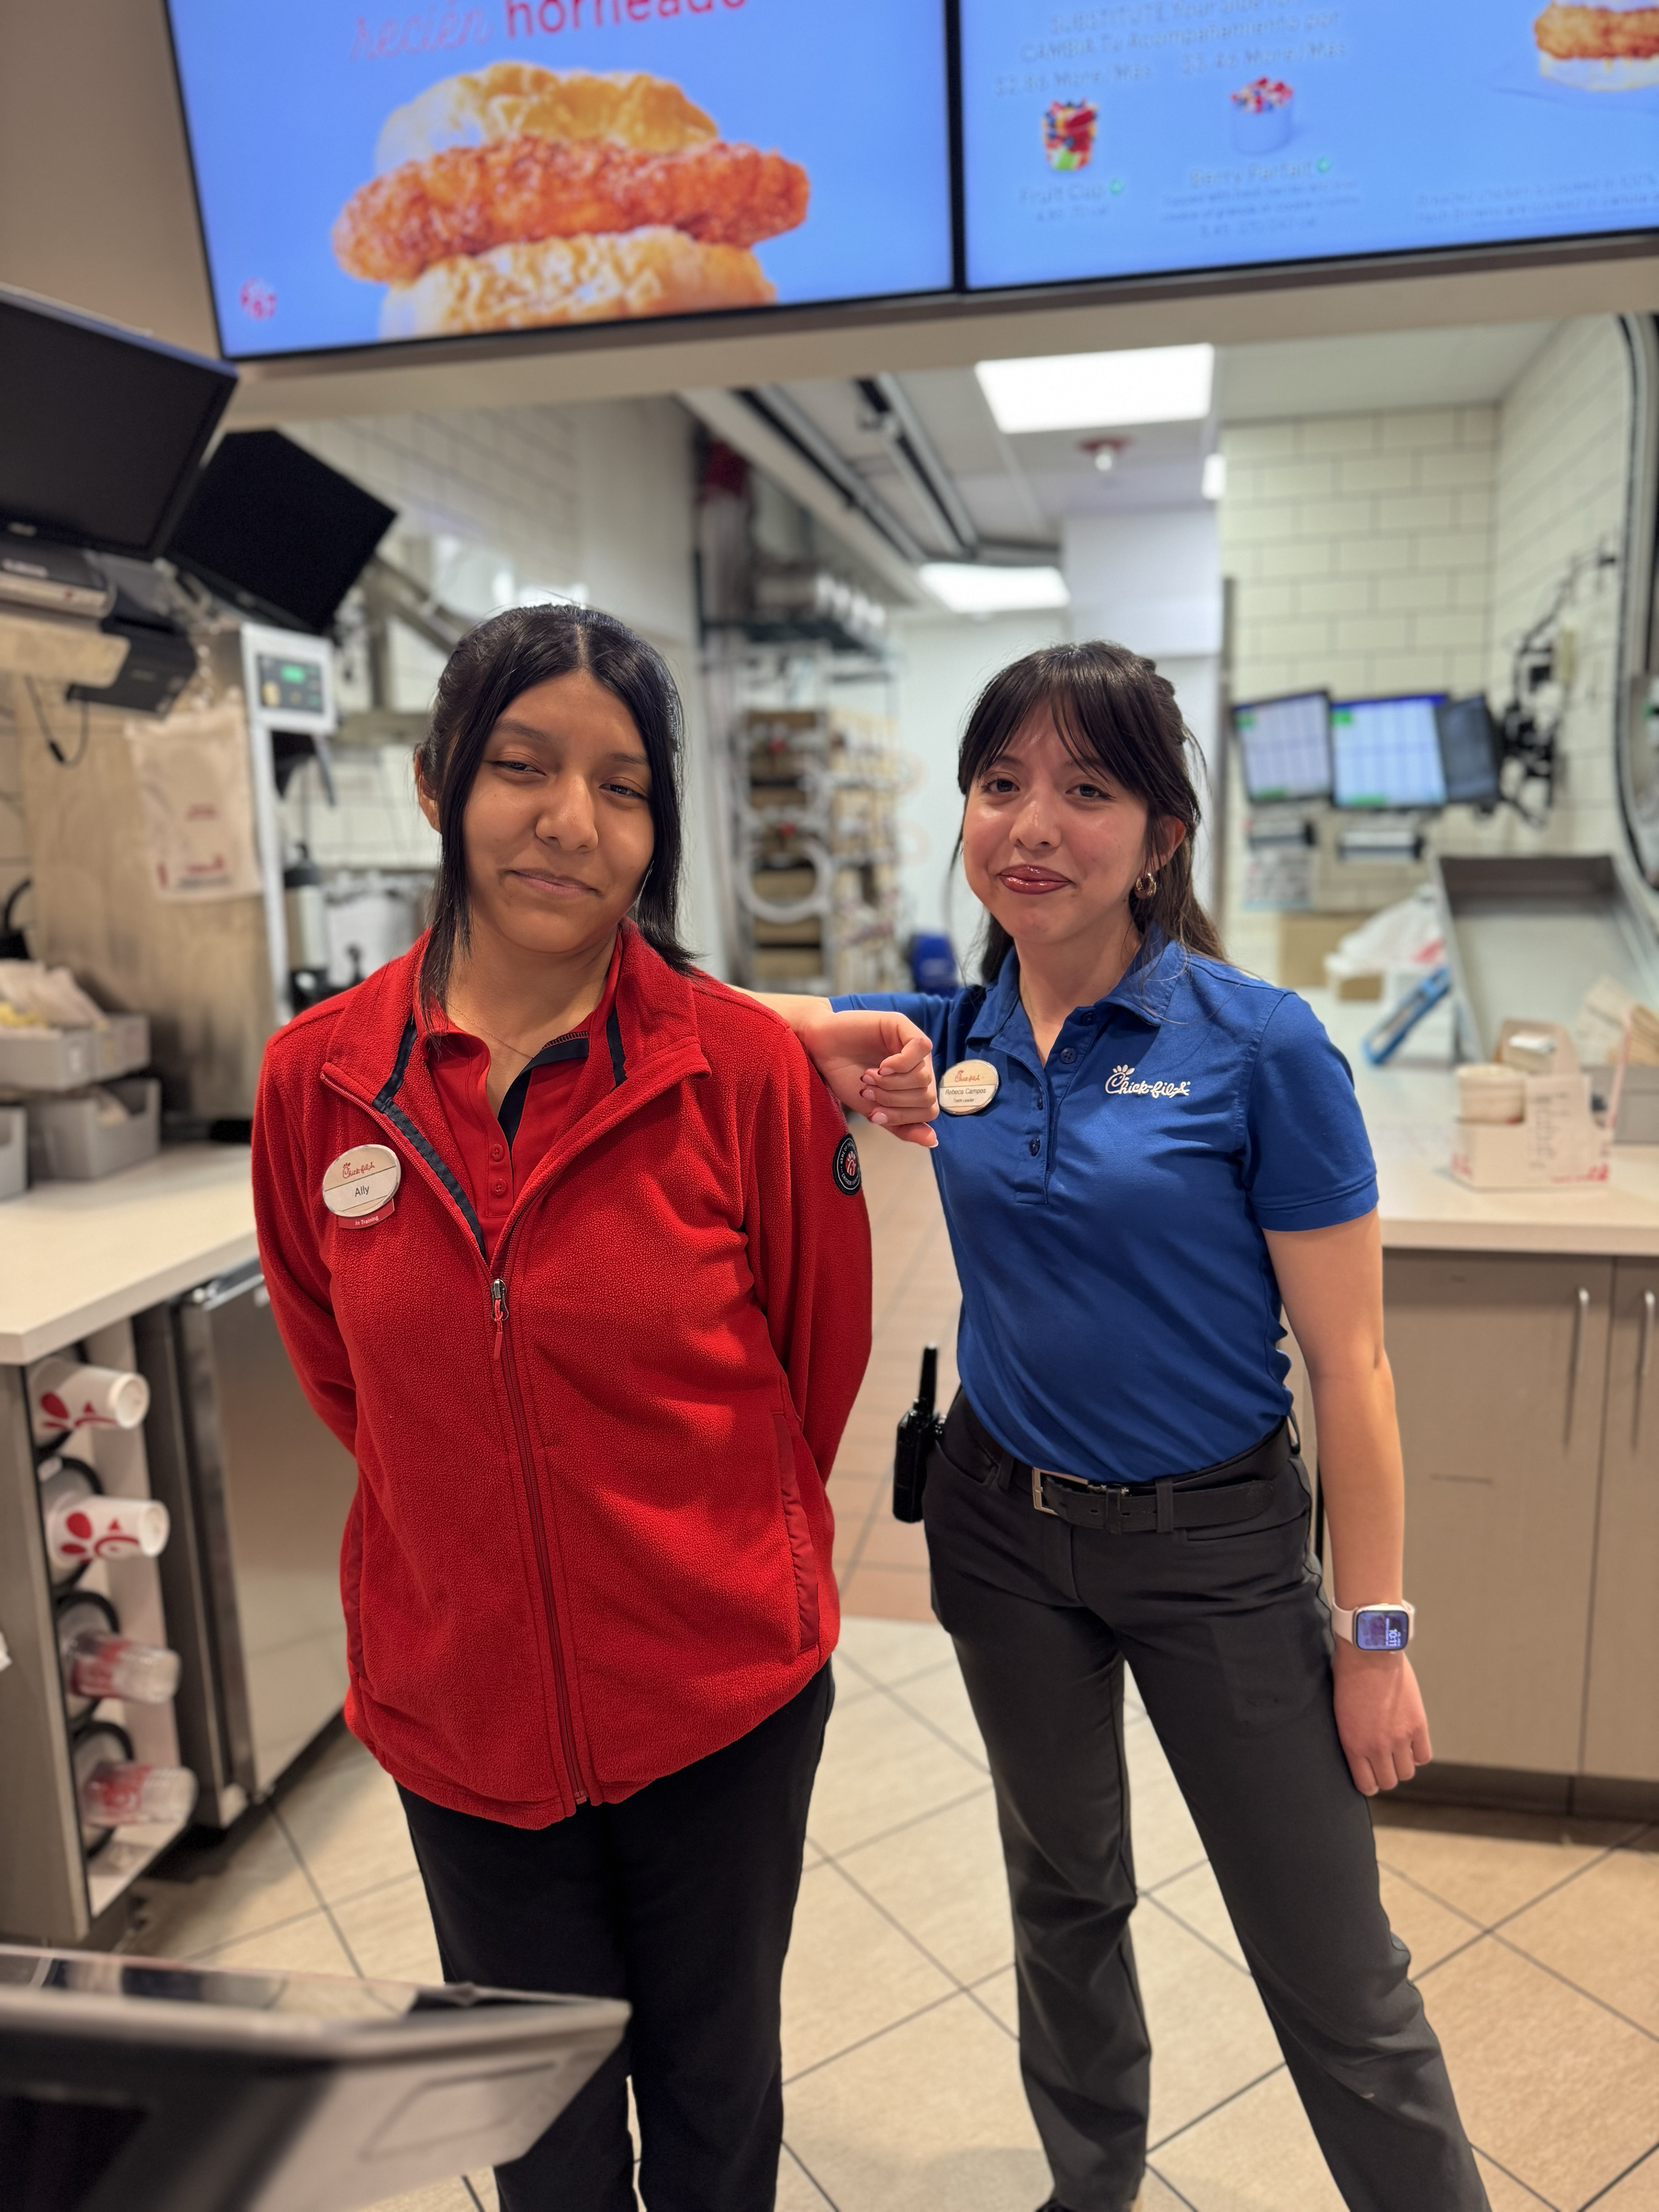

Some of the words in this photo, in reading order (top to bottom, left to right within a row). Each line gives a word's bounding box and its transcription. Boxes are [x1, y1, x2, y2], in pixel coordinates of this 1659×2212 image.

[1021, 37, 1096, 64] CAMBIA
[1105, 1065, 1191, 1098] Chick-fil-A
[342, 1162, 375, 1179] Chick-fil-A
[355, 1185, 370, 1197] Ally
[361, 1216, 379, 1224] Training
